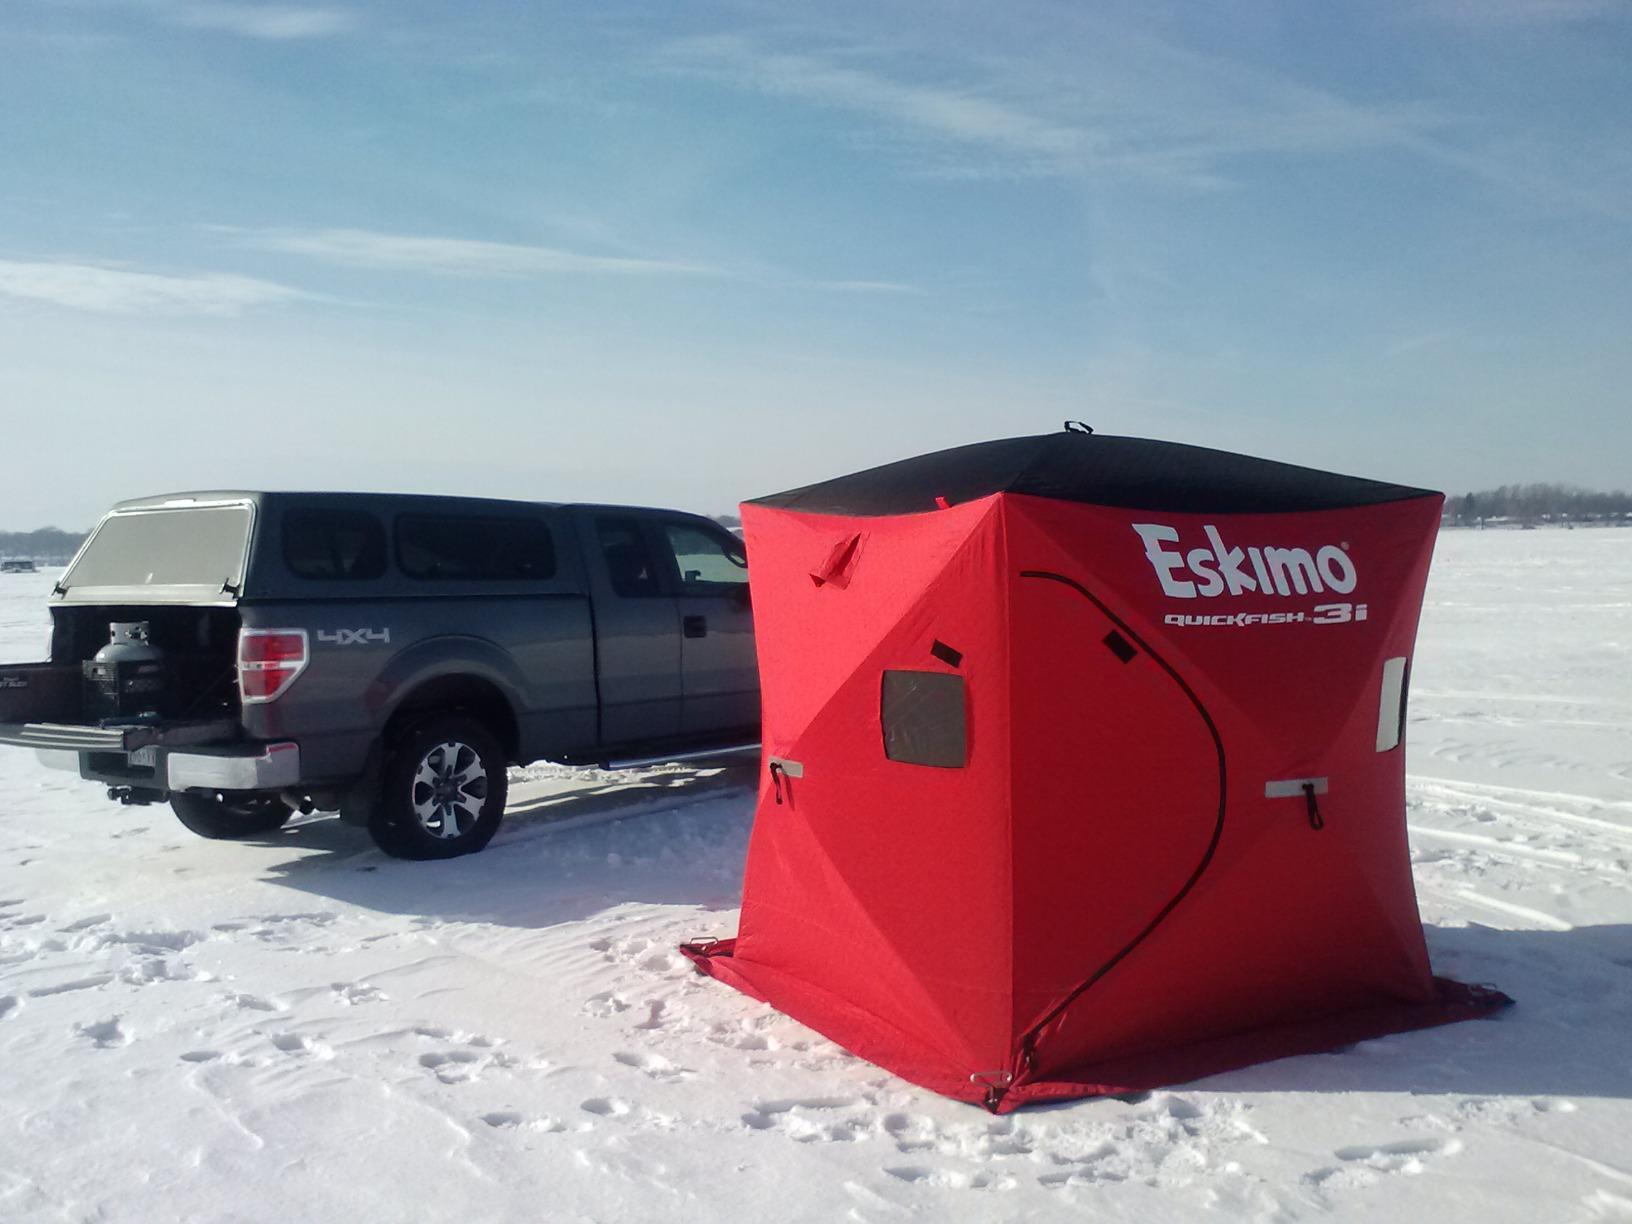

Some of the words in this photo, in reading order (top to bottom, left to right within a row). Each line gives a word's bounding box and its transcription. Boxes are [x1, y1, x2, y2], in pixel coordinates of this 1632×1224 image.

[1132, 523, 1358, 599] Eskimo
[1164, 612, 1305, 627] QUICKFISH
[1312, 602, 1368, 625] 3i
